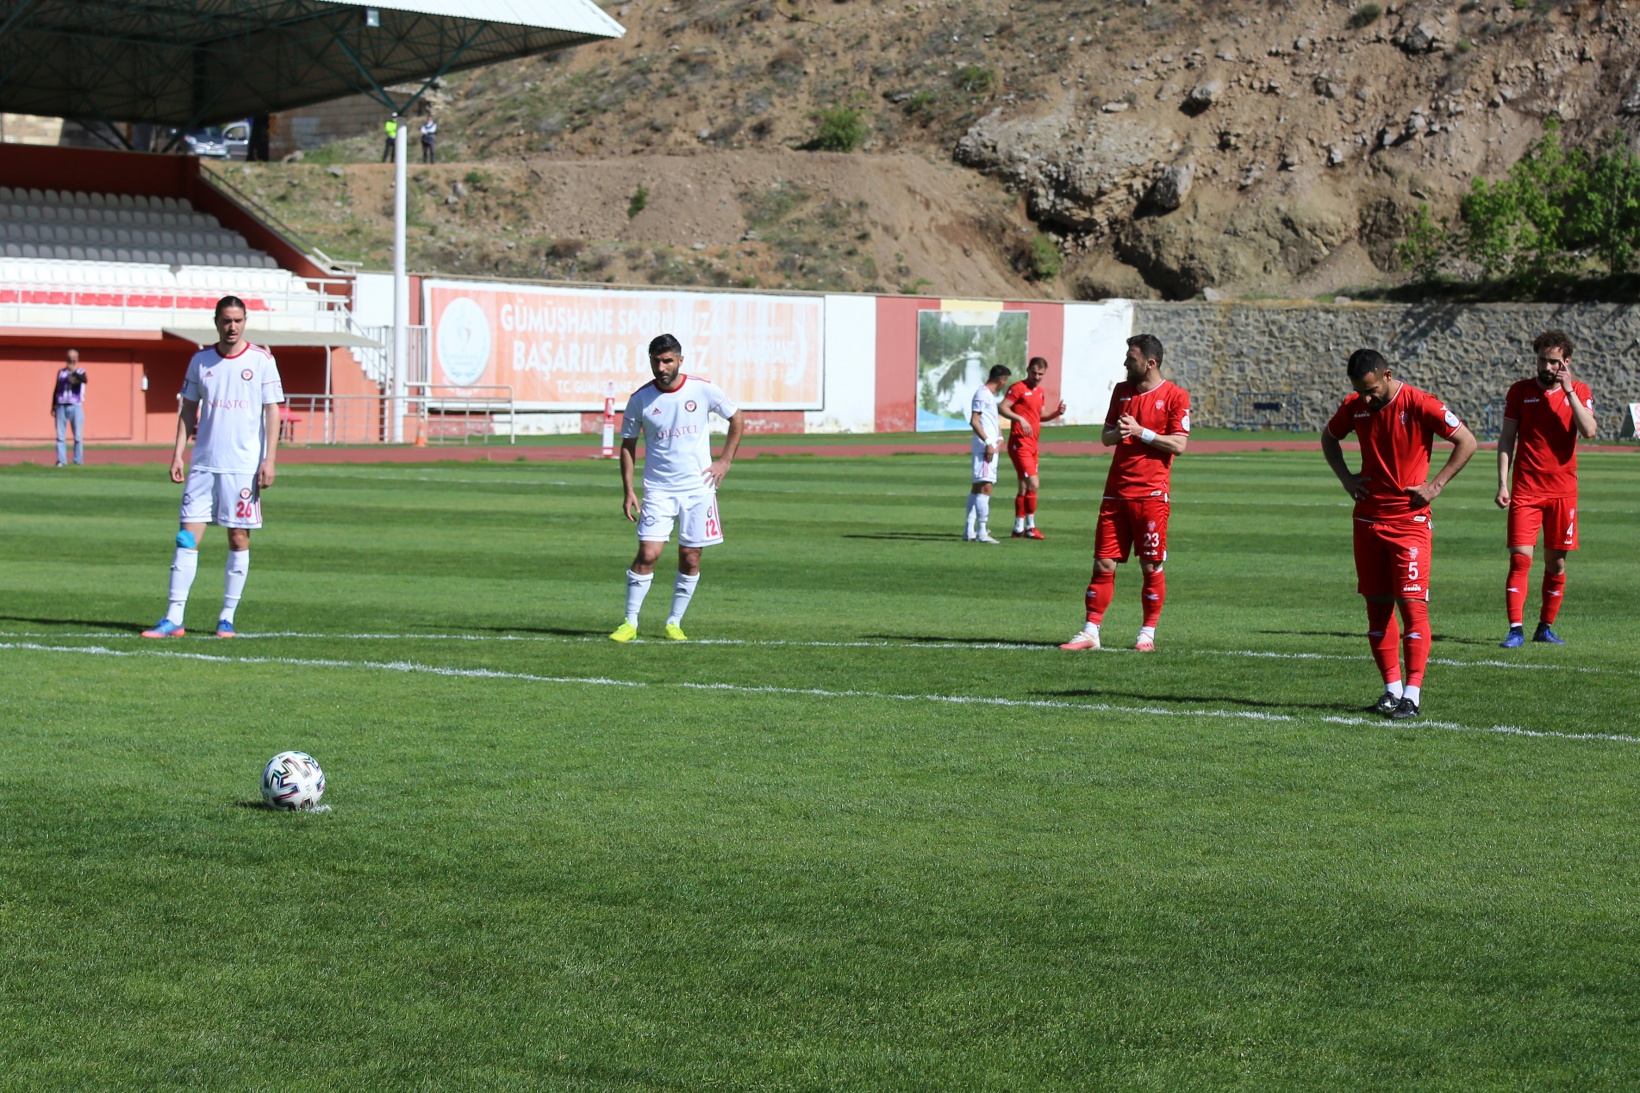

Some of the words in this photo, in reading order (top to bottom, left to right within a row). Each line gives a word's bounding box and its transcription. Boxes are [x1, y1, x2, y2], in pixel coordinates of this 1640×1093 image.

[501, 298, 613, 340] GÜMÜŞHANE
[513, 340, 628, 380] BAŞARILAR
[236, 501, 252, 518] 26
[705, 519, 718, 538] 12
[1566, 522, 1573, 537] 4
[1144, 532, 1159, 547] 23
[1408, 561, 1418, 580] 5
